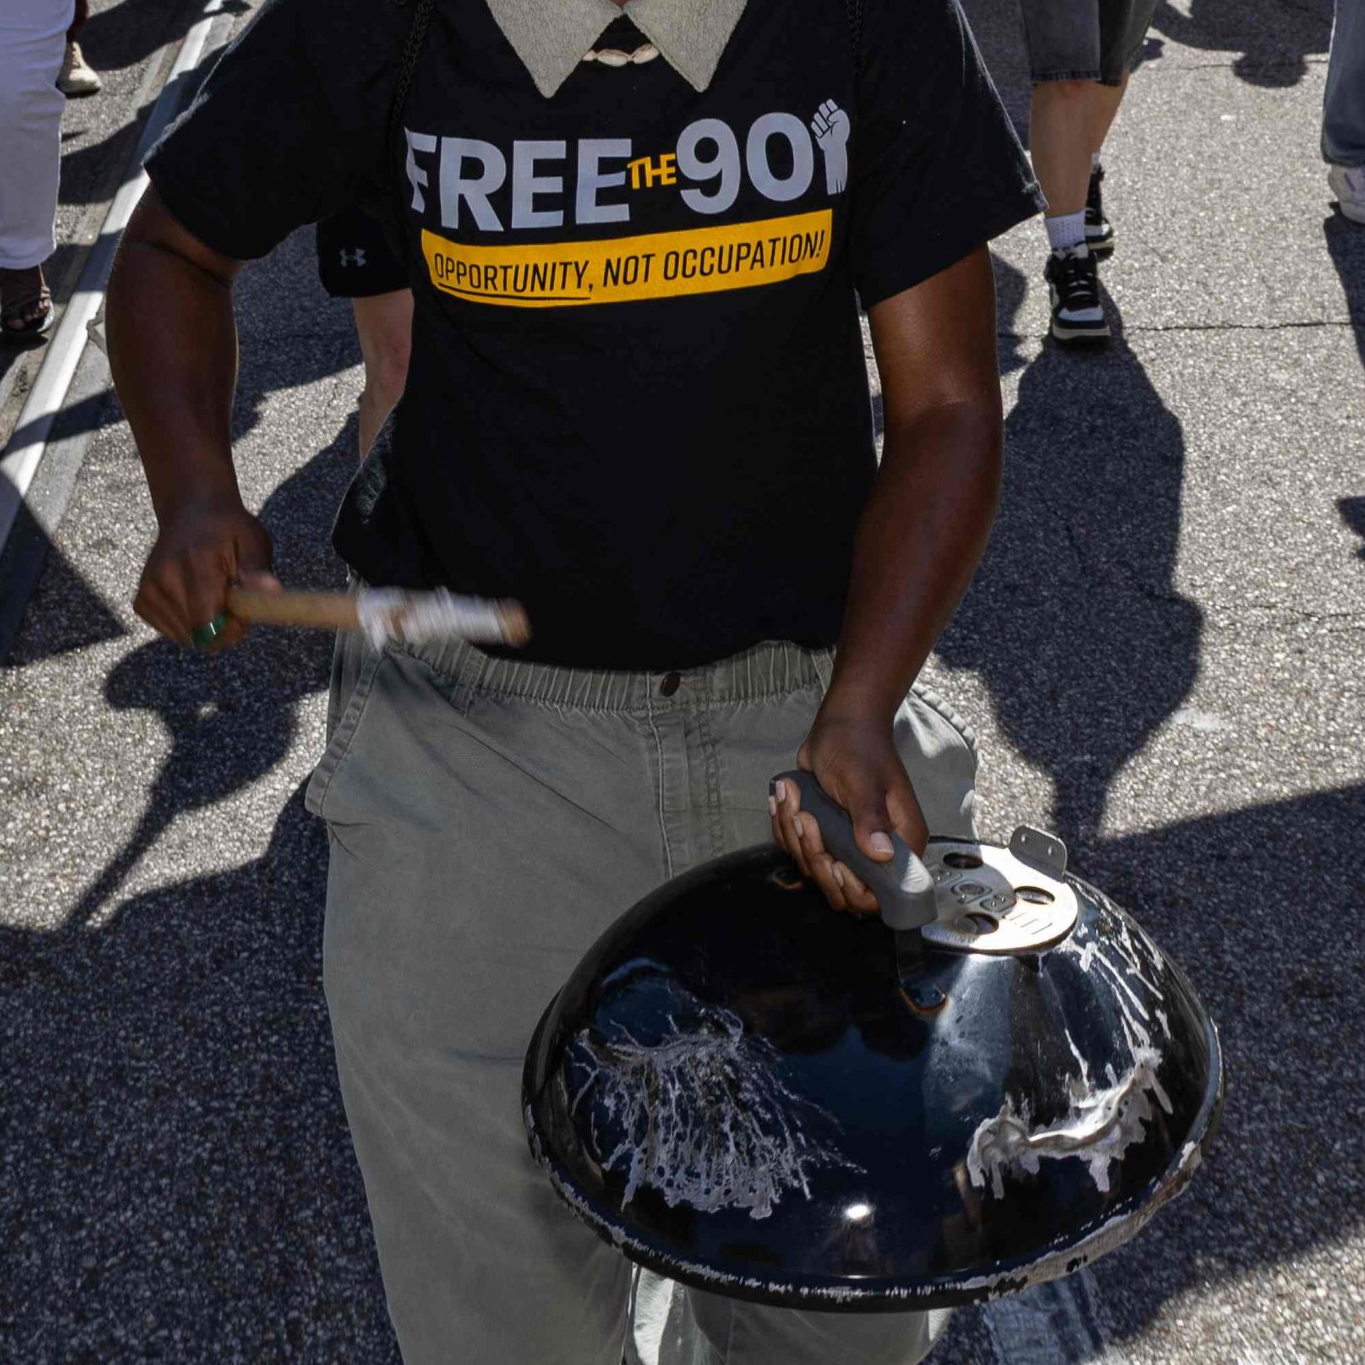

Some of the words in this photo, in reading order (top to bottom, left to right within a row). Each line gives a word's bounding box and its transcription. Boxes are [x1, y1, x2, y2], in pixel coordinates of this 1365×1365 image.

[404, 125, 632, 232] FREE
[627, 152, 677, 191] THE
[434, 252, 594, 294] OPPORTUNITY,
[602, 254, 657, 288] NOT
[663, 231, 825, 282] OCCUPATION!
